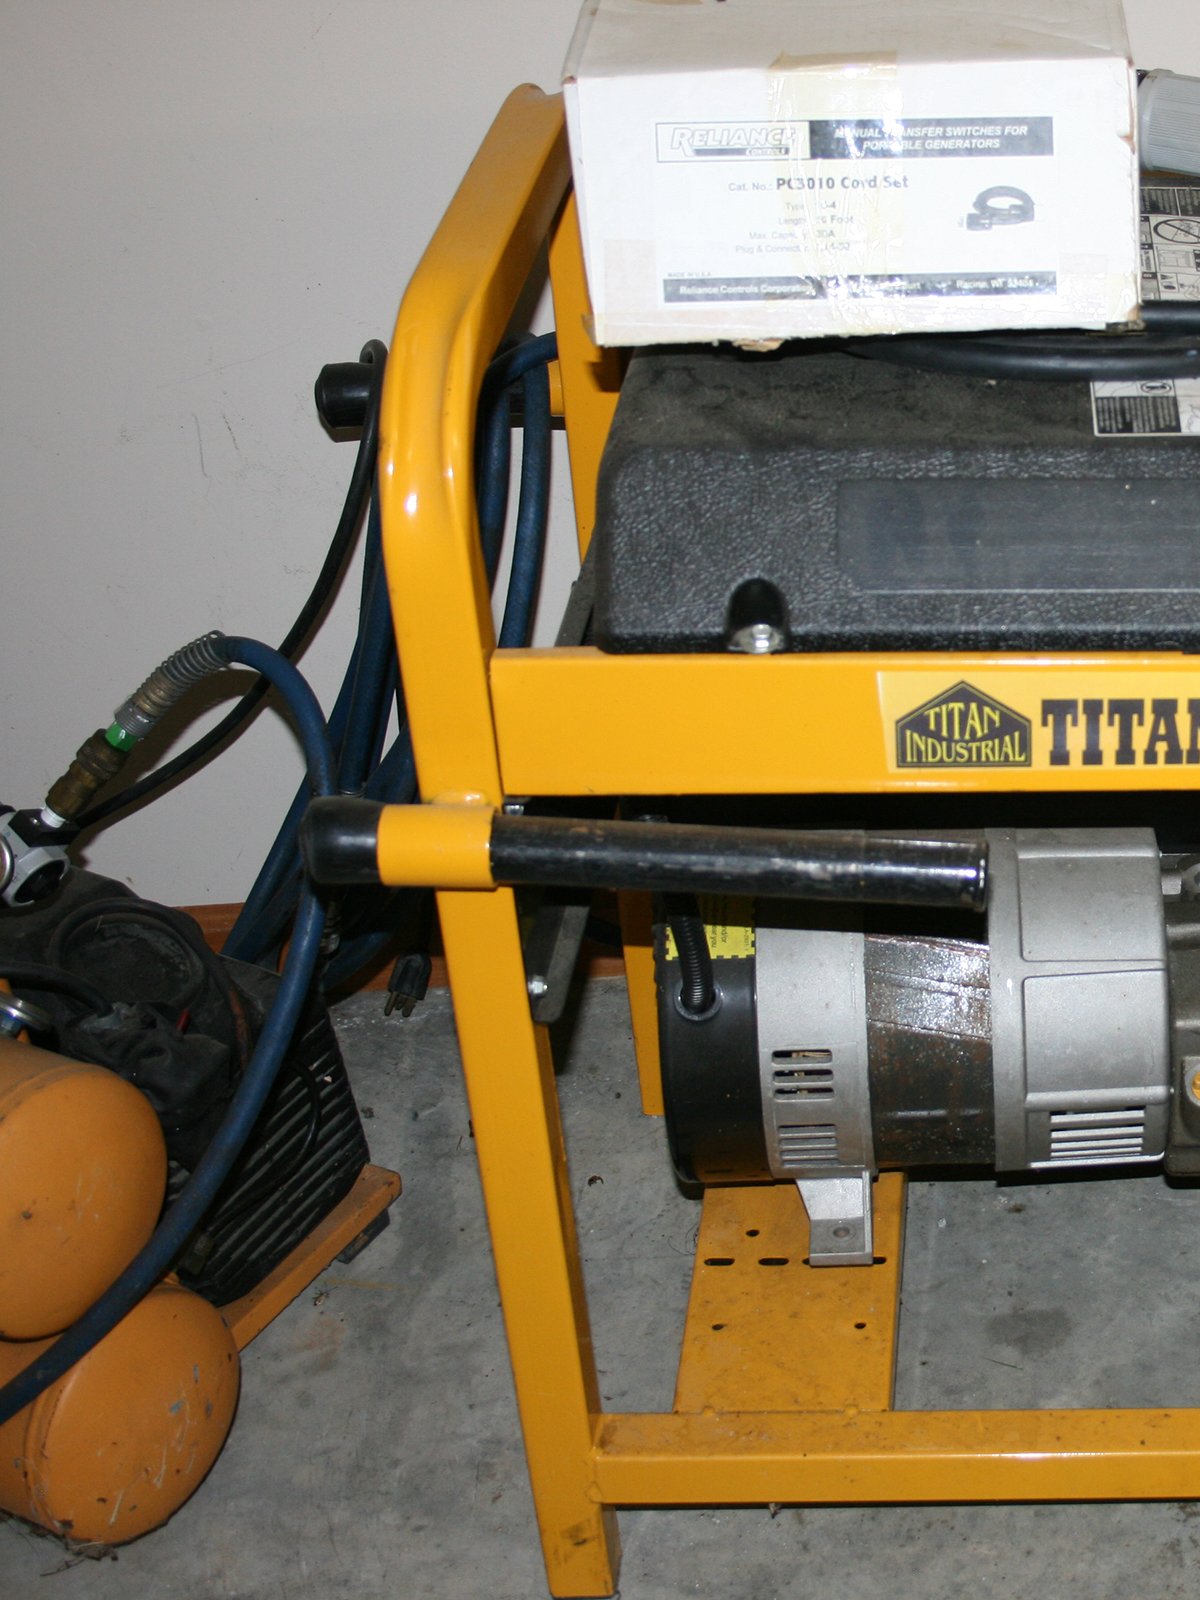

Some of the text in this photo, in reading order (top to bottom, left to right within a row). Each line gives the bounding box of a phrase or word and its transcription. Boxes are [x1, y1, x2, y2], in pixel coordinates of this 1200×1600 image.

[945, 125, 1003, 138] SWITCHES
[1004, 125, 1028, 137] FOR
[924, 137, 1001, 150] GENERATORS
[882, 174, 910, 189] Set
[679, 285, 719, 295] Reliance
[720, 284, 759, 294] Controls
[923, 701, 1001, 741] TITAN
[904, 729, 1027, 764] INDUSTRIAL
